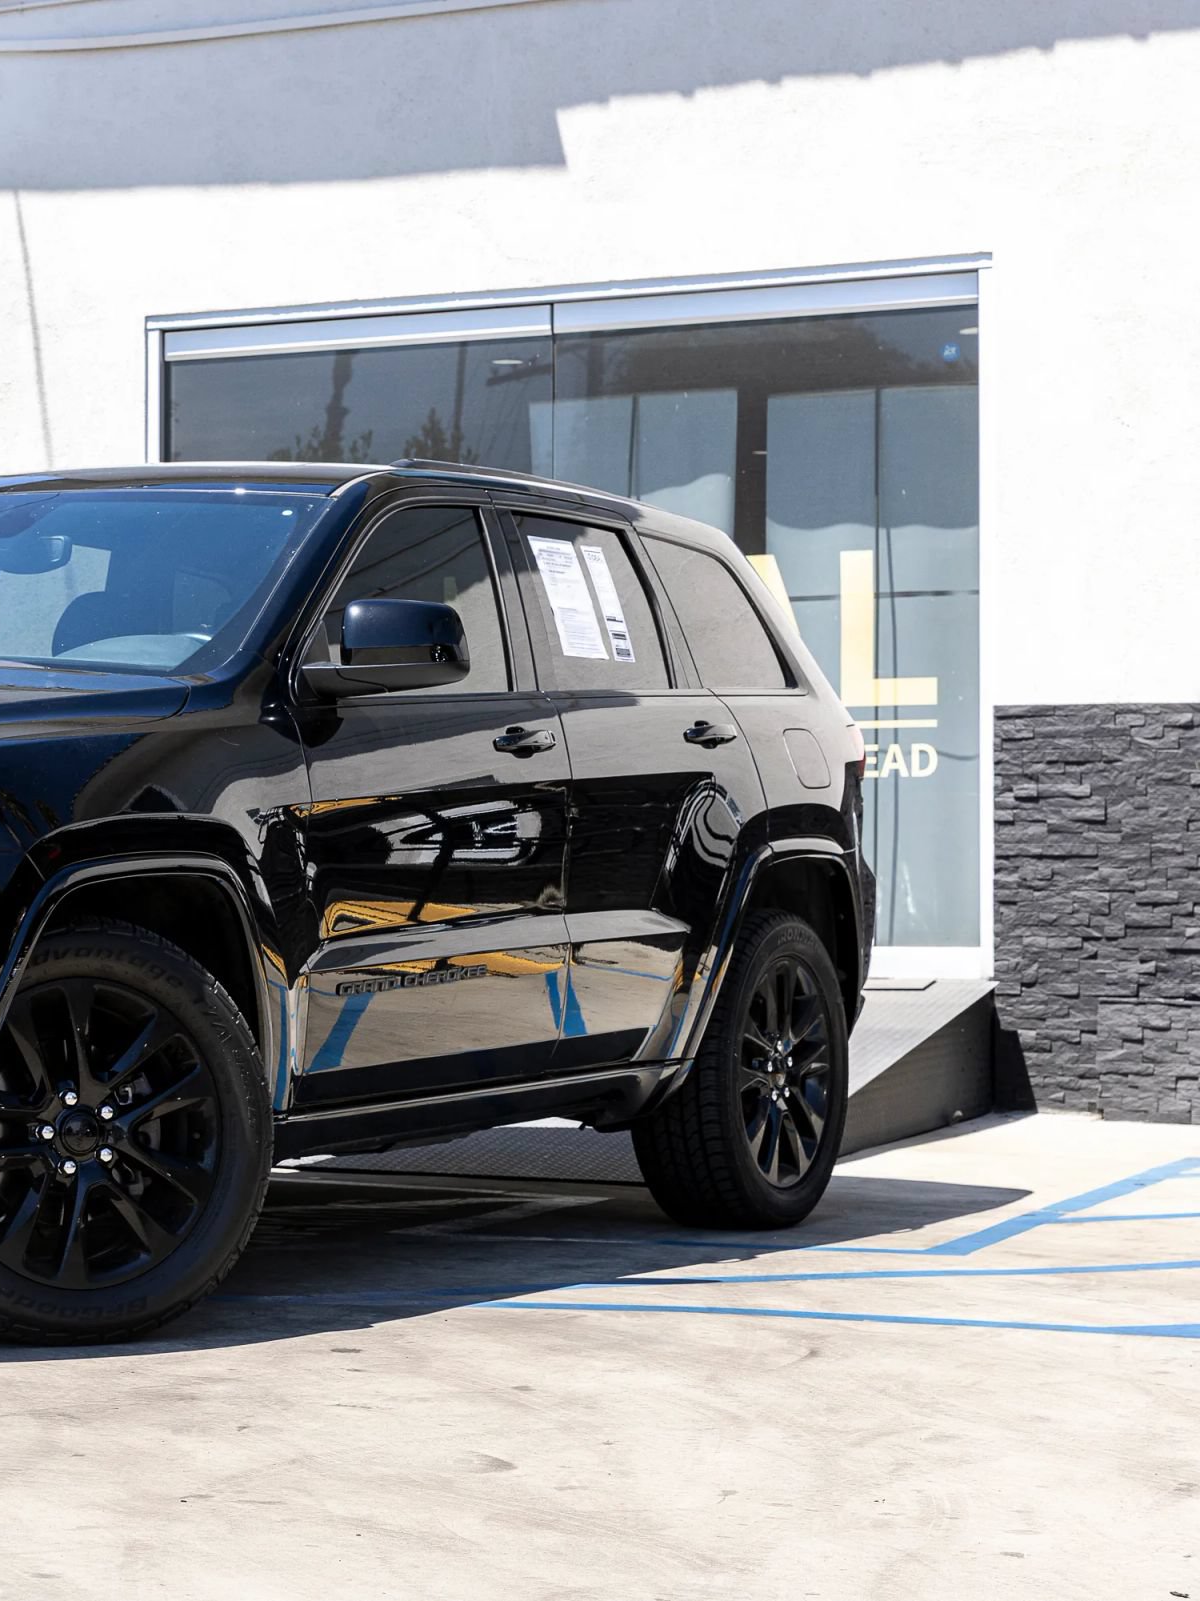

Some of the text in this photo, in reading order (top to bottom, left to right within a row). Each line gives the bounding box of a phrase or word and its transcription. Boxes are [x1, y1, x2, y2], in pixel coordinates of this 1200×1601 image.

[864, 743, 938, 778] EAD
[31, 946, 184, 989] dvantage
[337, 964, 488, 996] GRAND CHEROKEE
